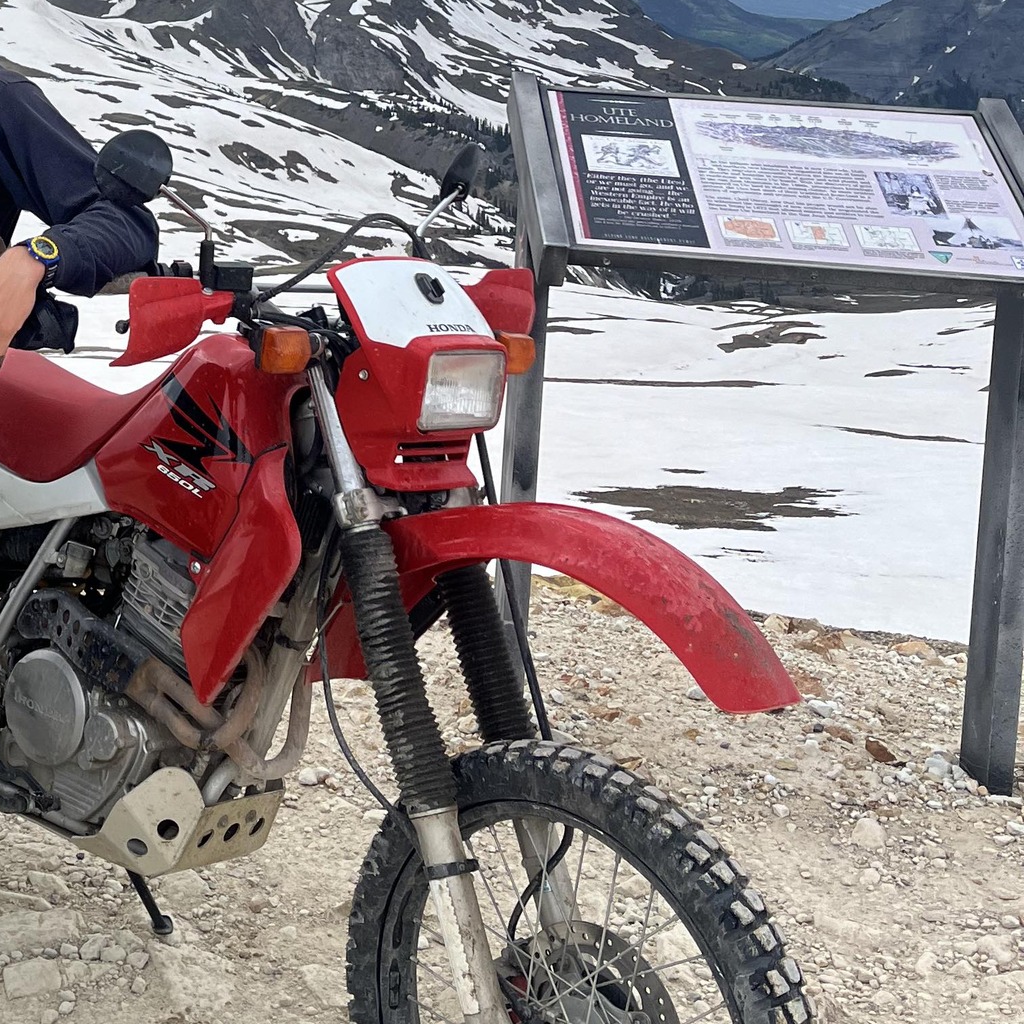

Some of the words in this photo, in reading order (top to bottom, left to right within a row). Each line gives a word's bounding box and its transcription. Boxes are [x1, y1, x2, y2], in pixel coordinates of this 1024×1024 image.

[602, 107, 638, 117] UTE
[570, 113, 674, 128] HOMELAND
[425, 323, 477, 333] HONDA
[142, 439, 217, 492] XR
[156, 463, 203, 499] 650L
